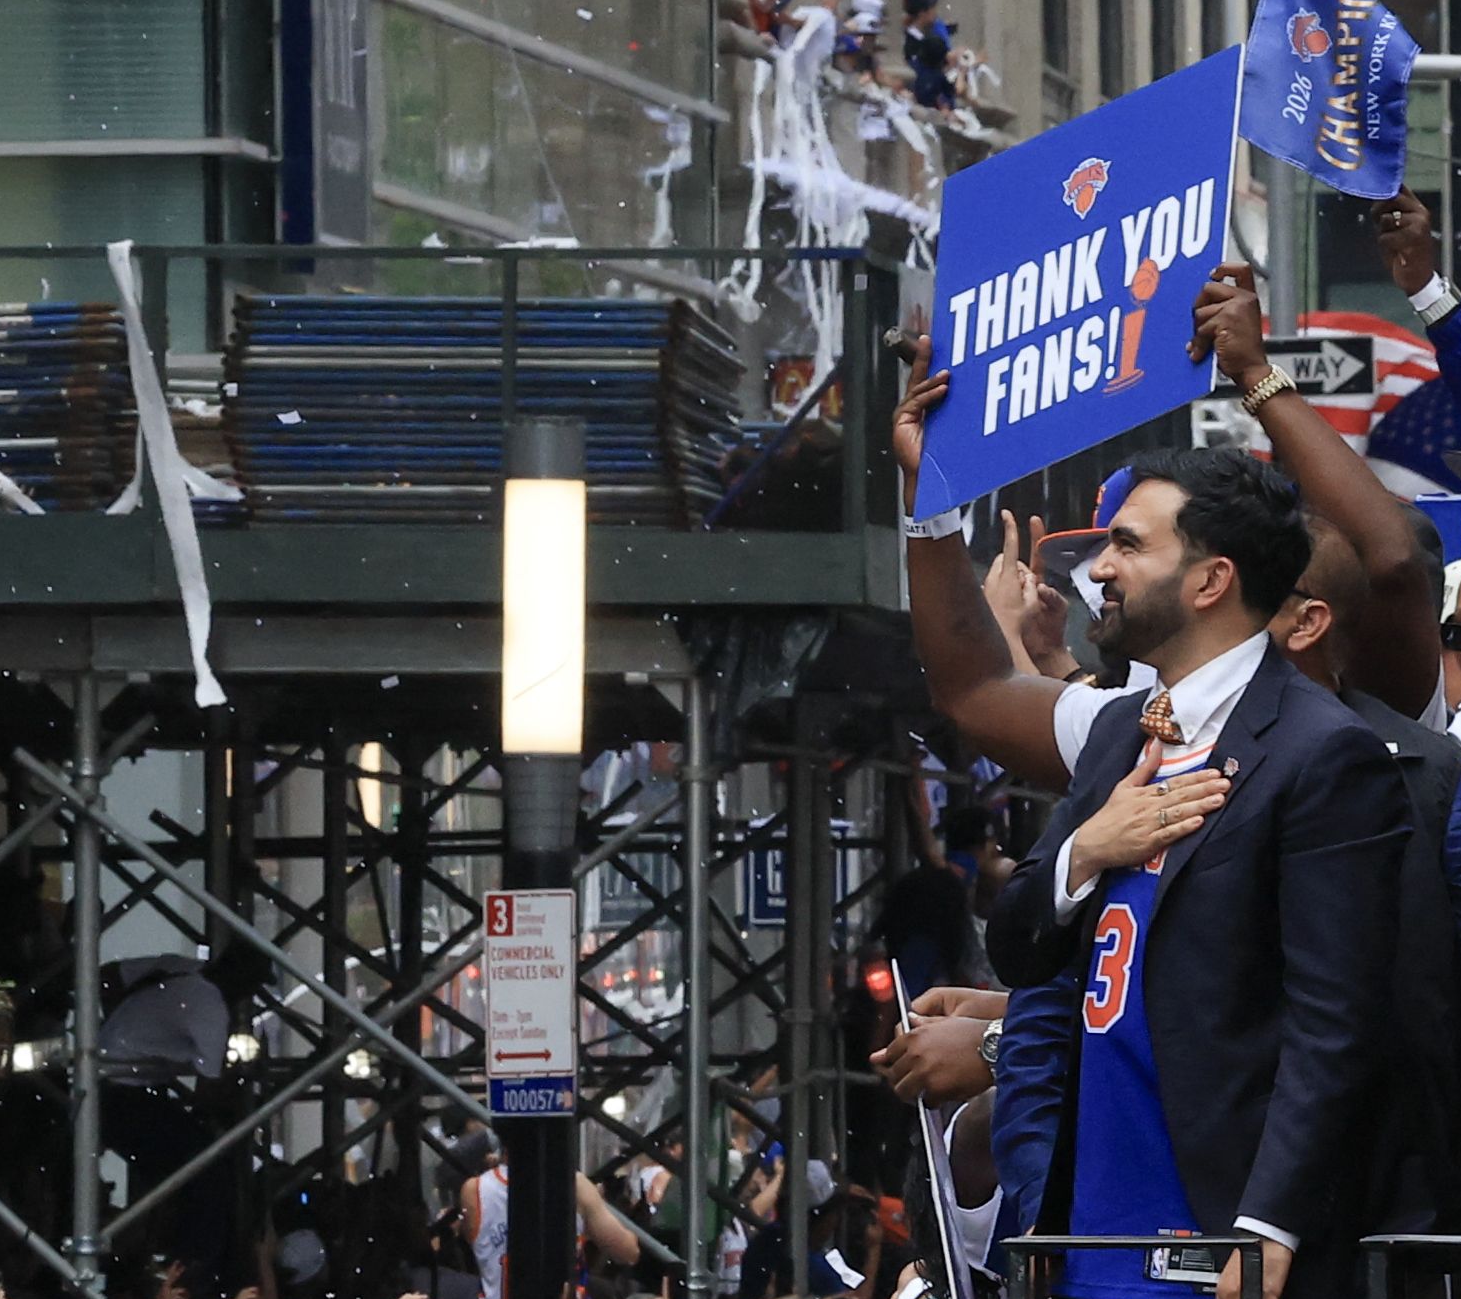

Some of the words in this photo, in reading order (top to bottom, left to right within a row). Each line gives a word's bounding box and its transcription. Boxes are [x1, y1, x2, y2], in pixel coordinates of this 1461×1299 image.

[1282, 73, 1313, 125] 2026
[1366, 91, 1380, 140] NEW
[949, 227, 1108, 368] THANK
[1120, 178, 1215, 288] YOU
[983, 306, 1121, 437] FANS!
[1293, 357, 1346, 379] WAY
[493, 898, 509, 934] 3
[491, 946, 556, 962] COMMERCIAL
[492, 966, 539, 981] VEHICLES
[540, 965, 565, 980] ONLY
